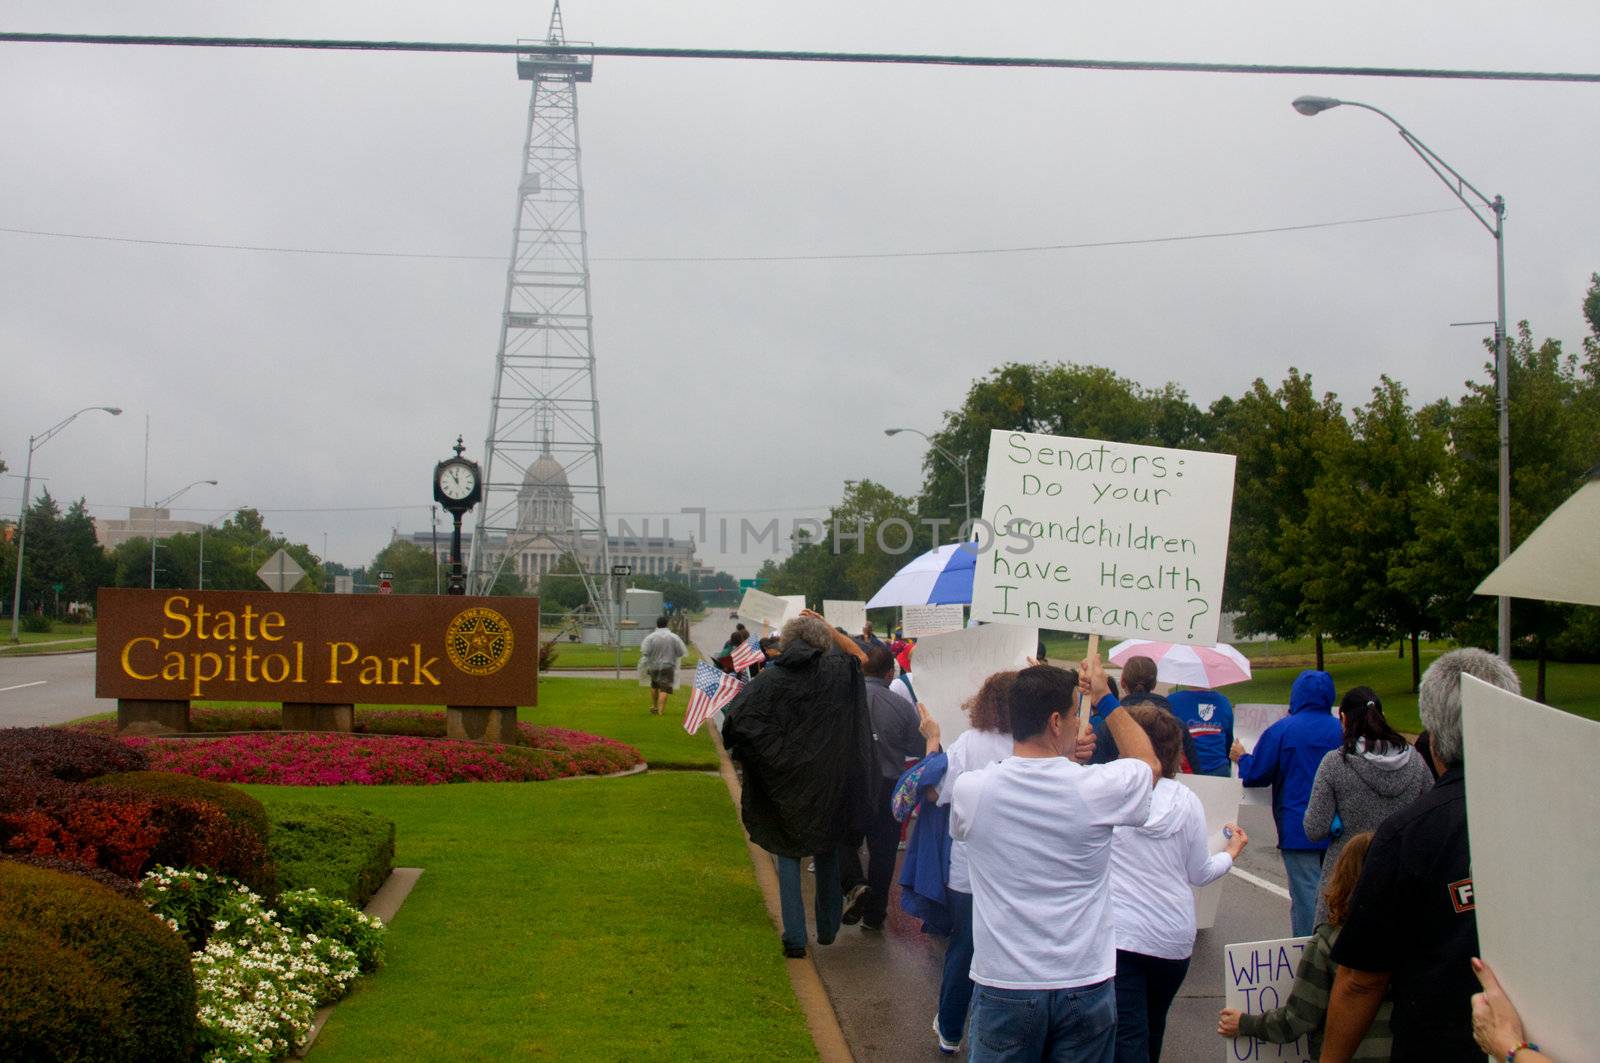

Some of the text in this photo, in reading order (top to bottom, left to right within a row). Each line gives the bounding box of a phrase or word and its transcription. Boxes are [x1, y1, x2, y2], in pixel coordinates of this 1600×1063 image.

[1007, 433, 1186, 479] Senators:
[1022, 473, 1172, 506] Do your
[993, 504, 1197, 555] Grandchildren
[993, 549, 1201, 592] have Health
[162, 595, 286, 642] State
[992, 585, 1209, 640] Insurance?
[121, 636, 307, 697] Capitol
[325, 641, 442, 686] Park
[1457, 884, 1473, 905] F
[1238, 986, 1279, 1015] TO
